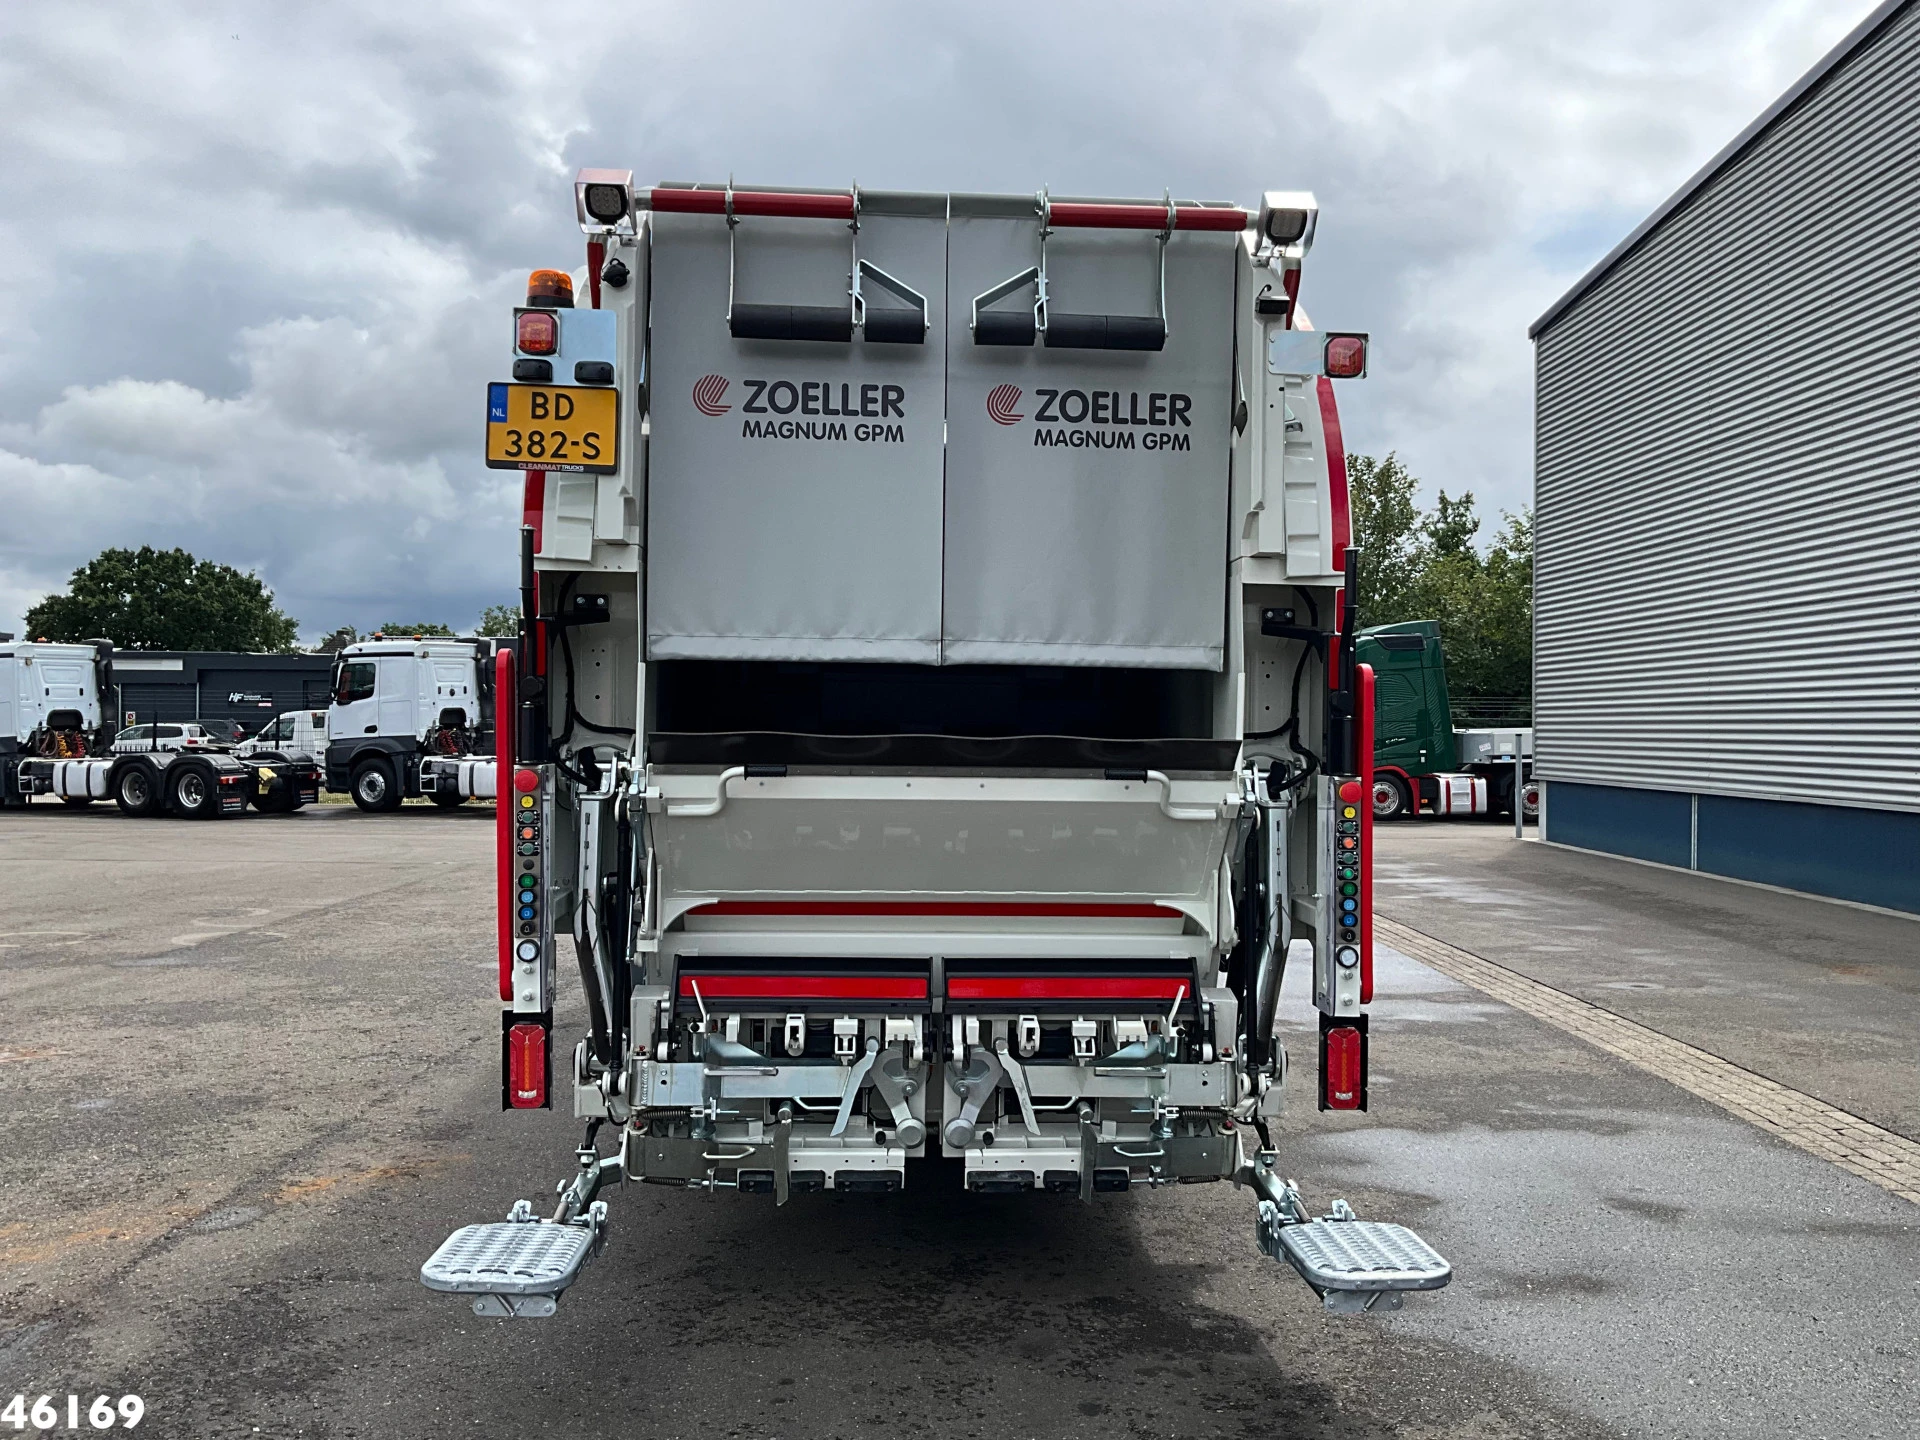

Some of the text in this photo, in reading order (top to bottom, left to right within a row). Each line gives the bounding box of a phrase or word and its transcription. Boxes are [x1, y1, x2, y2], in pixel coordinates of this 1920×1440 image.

[492, 407, 506, 417] NL
[531, 391, 575, 421] BD
[742, 379, 905, 419] ZOELLER
[1034, 388, 1192, 427] ZOELLER
[504, 429, 601, 460] 382-S
[742, 419, 905, 443] MAGNUM GPM
[1033, 428, 1191, 452] MAGNUM GPM
[228, 692, 244, 703] HF
